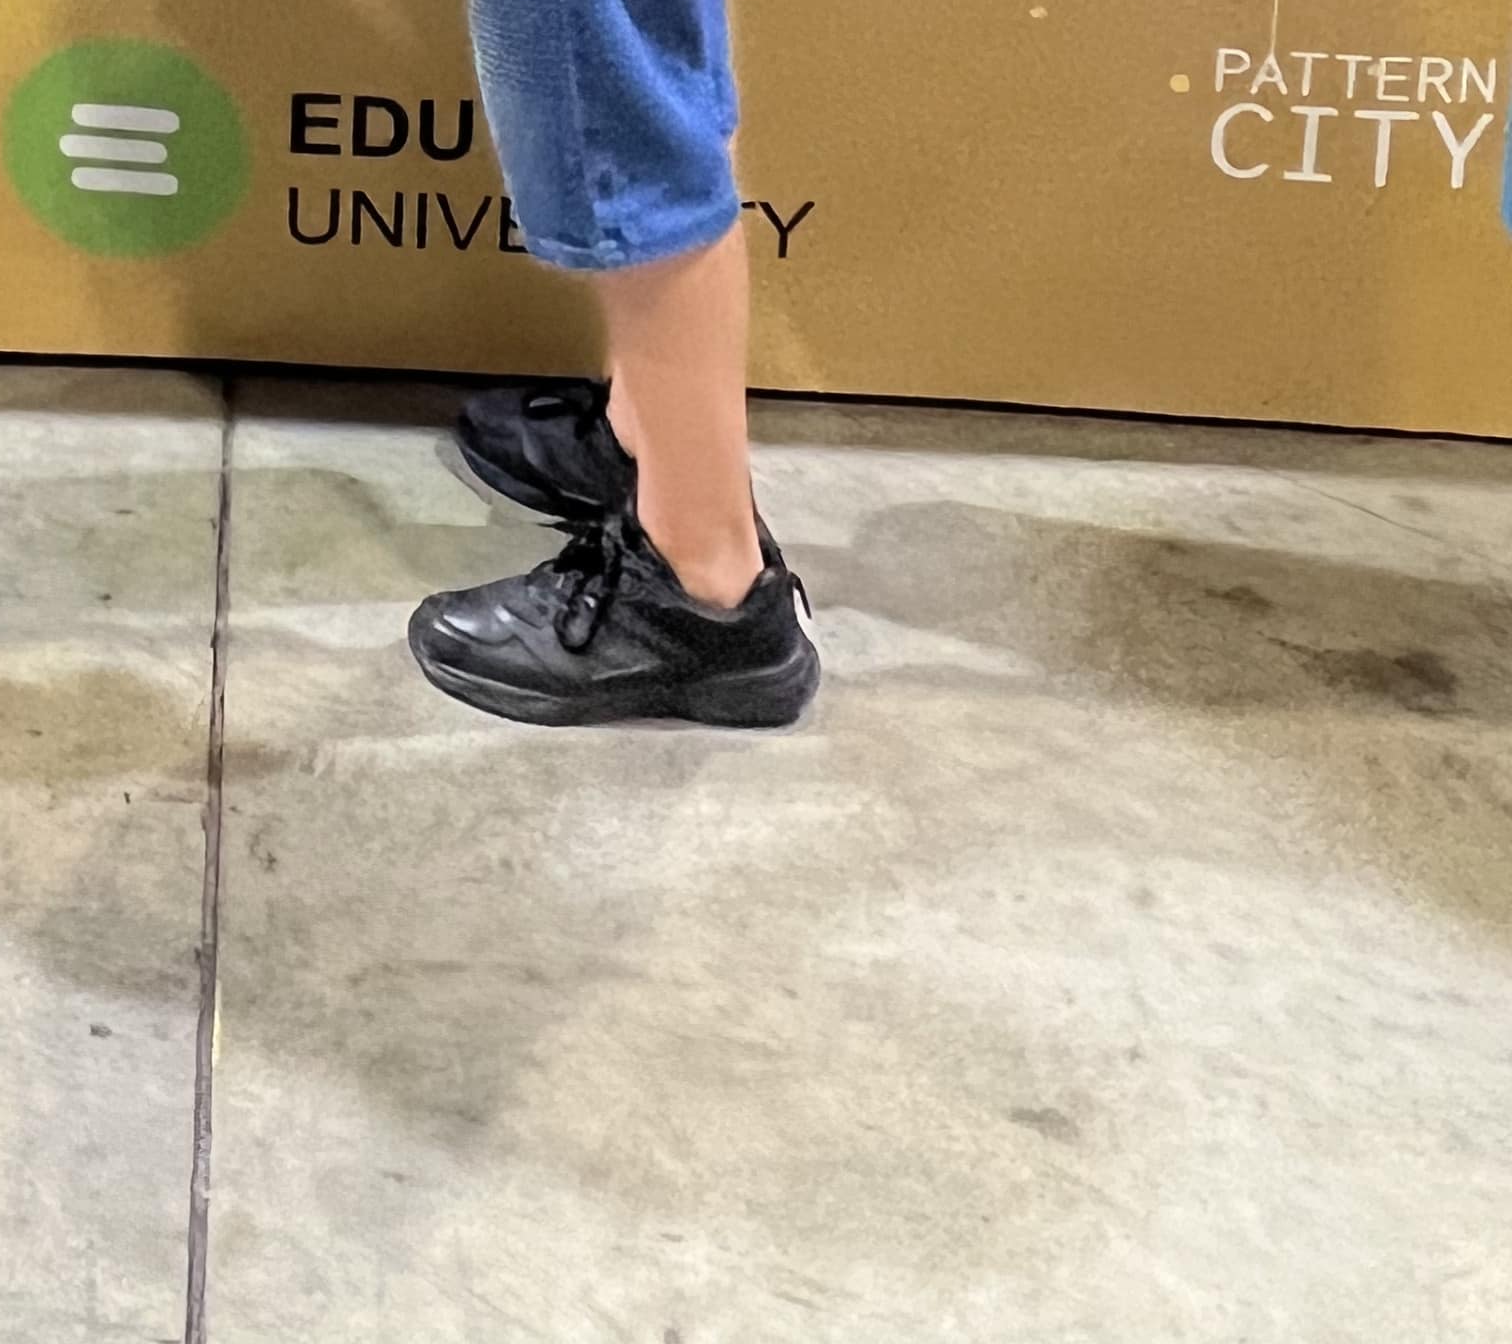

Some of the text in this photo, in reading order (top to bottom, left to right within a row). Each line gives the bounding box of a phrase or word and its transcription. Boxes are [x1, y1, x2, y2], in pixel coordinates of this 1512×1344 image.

[1214, 47, 1498, 104] PATTERN
[289, 92, 475, 161] EDU
[1210, 102, 1495, 190] CITY
